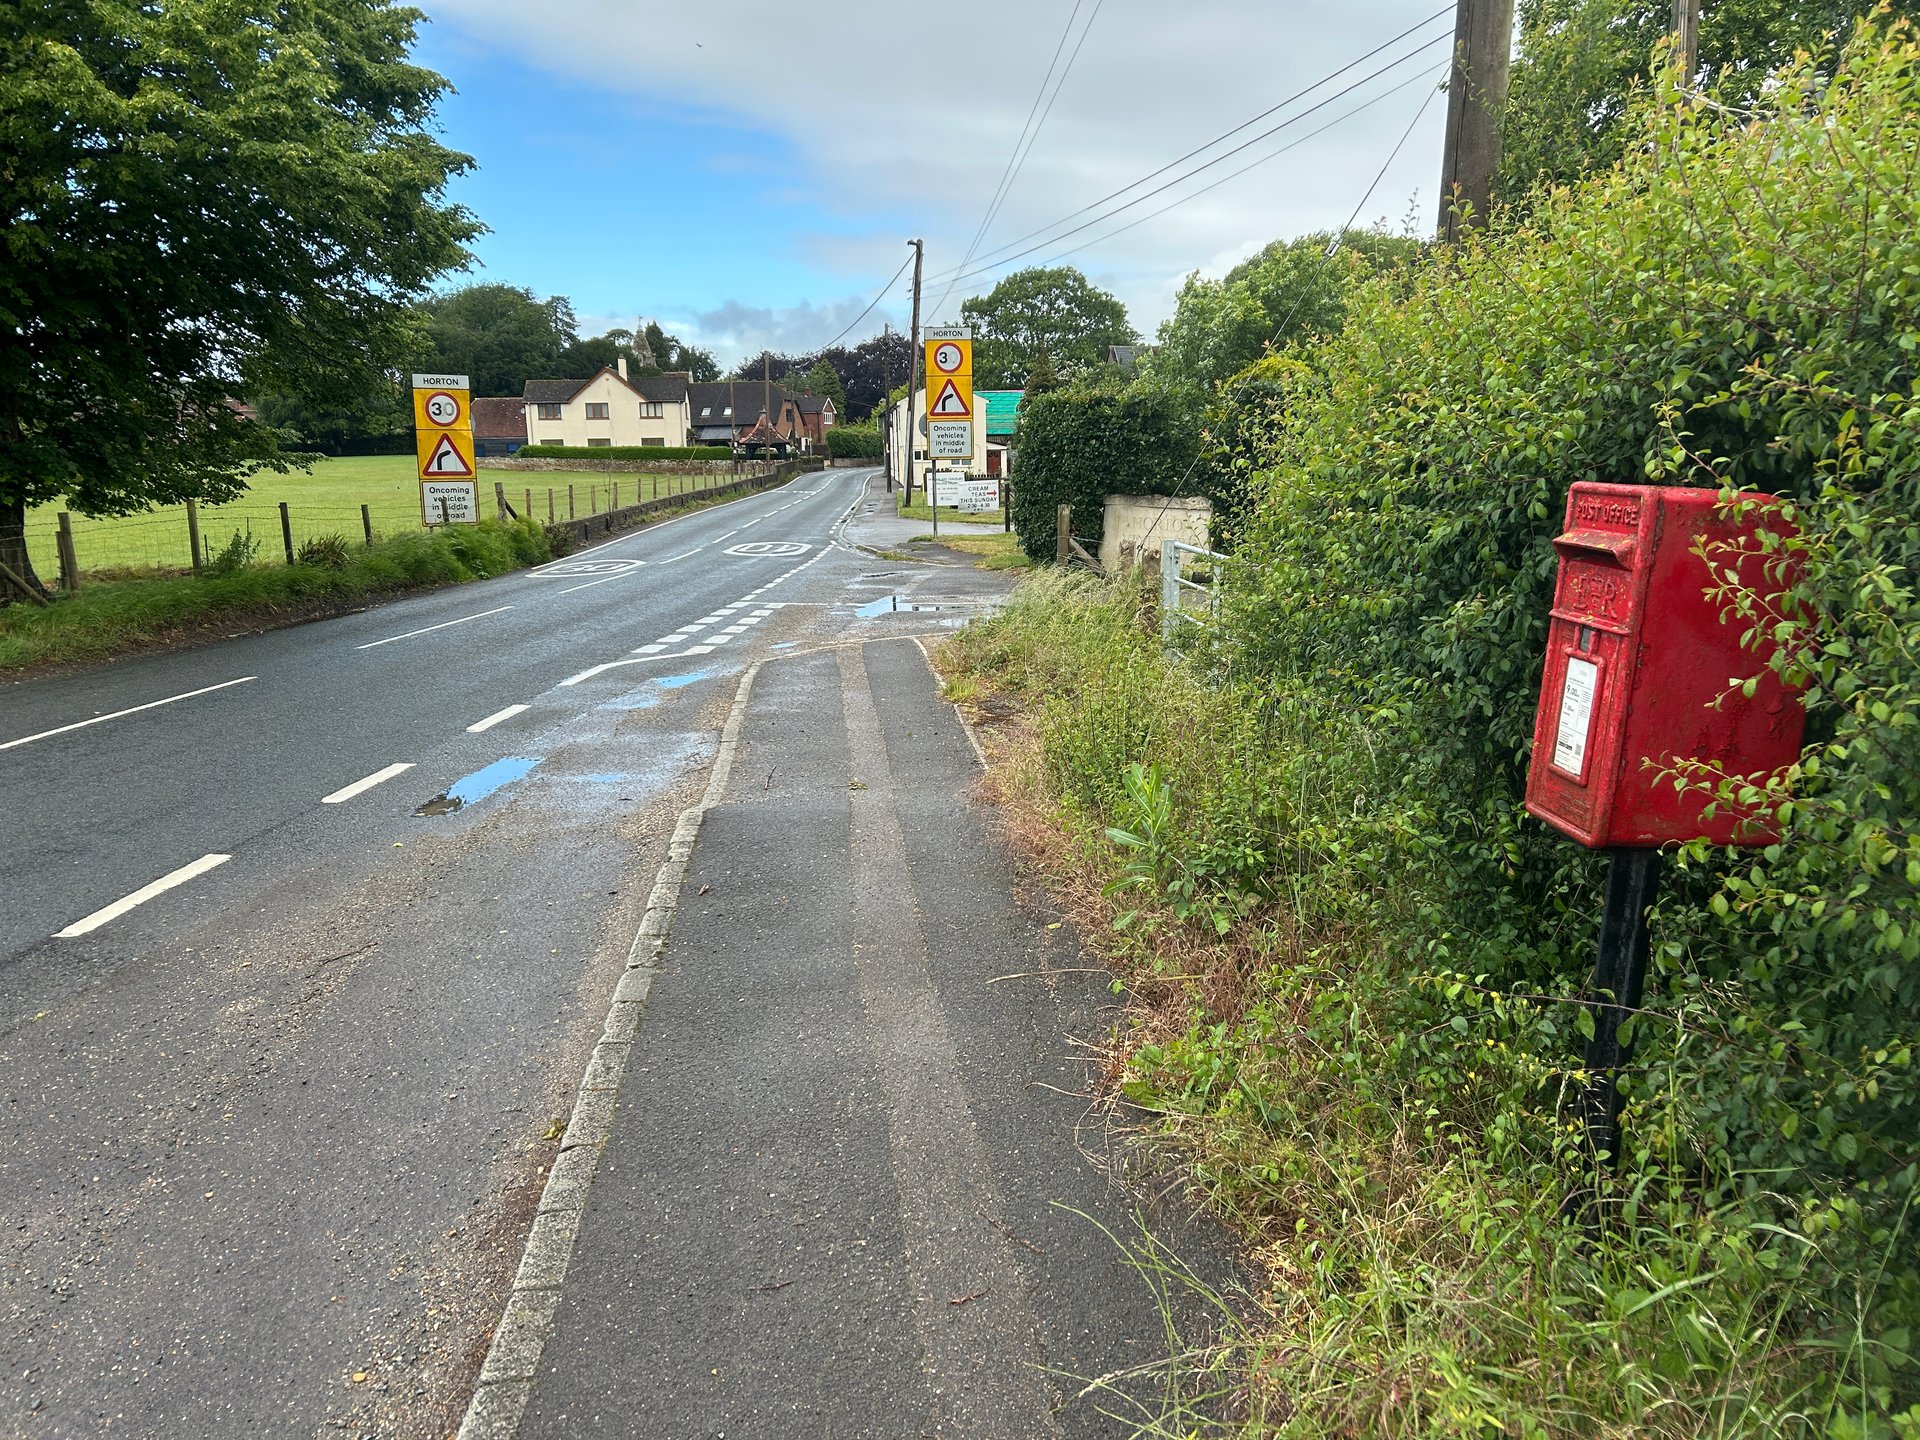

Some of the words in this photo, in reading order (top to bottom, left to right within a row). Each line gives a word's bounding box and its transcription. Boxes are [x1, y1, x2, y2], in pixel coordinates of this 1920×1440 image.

[423, 377, 459, 386] HORTON
[431, 402, 455, 416] 30
[429, 486, 470, 494] Oncoming
[432, 503, 440, 511] in
[442, 503, 469, 511] iddle
[1576, 501, 1601, 521] POST
[1603, 504, 1640, 526] OFFICE
